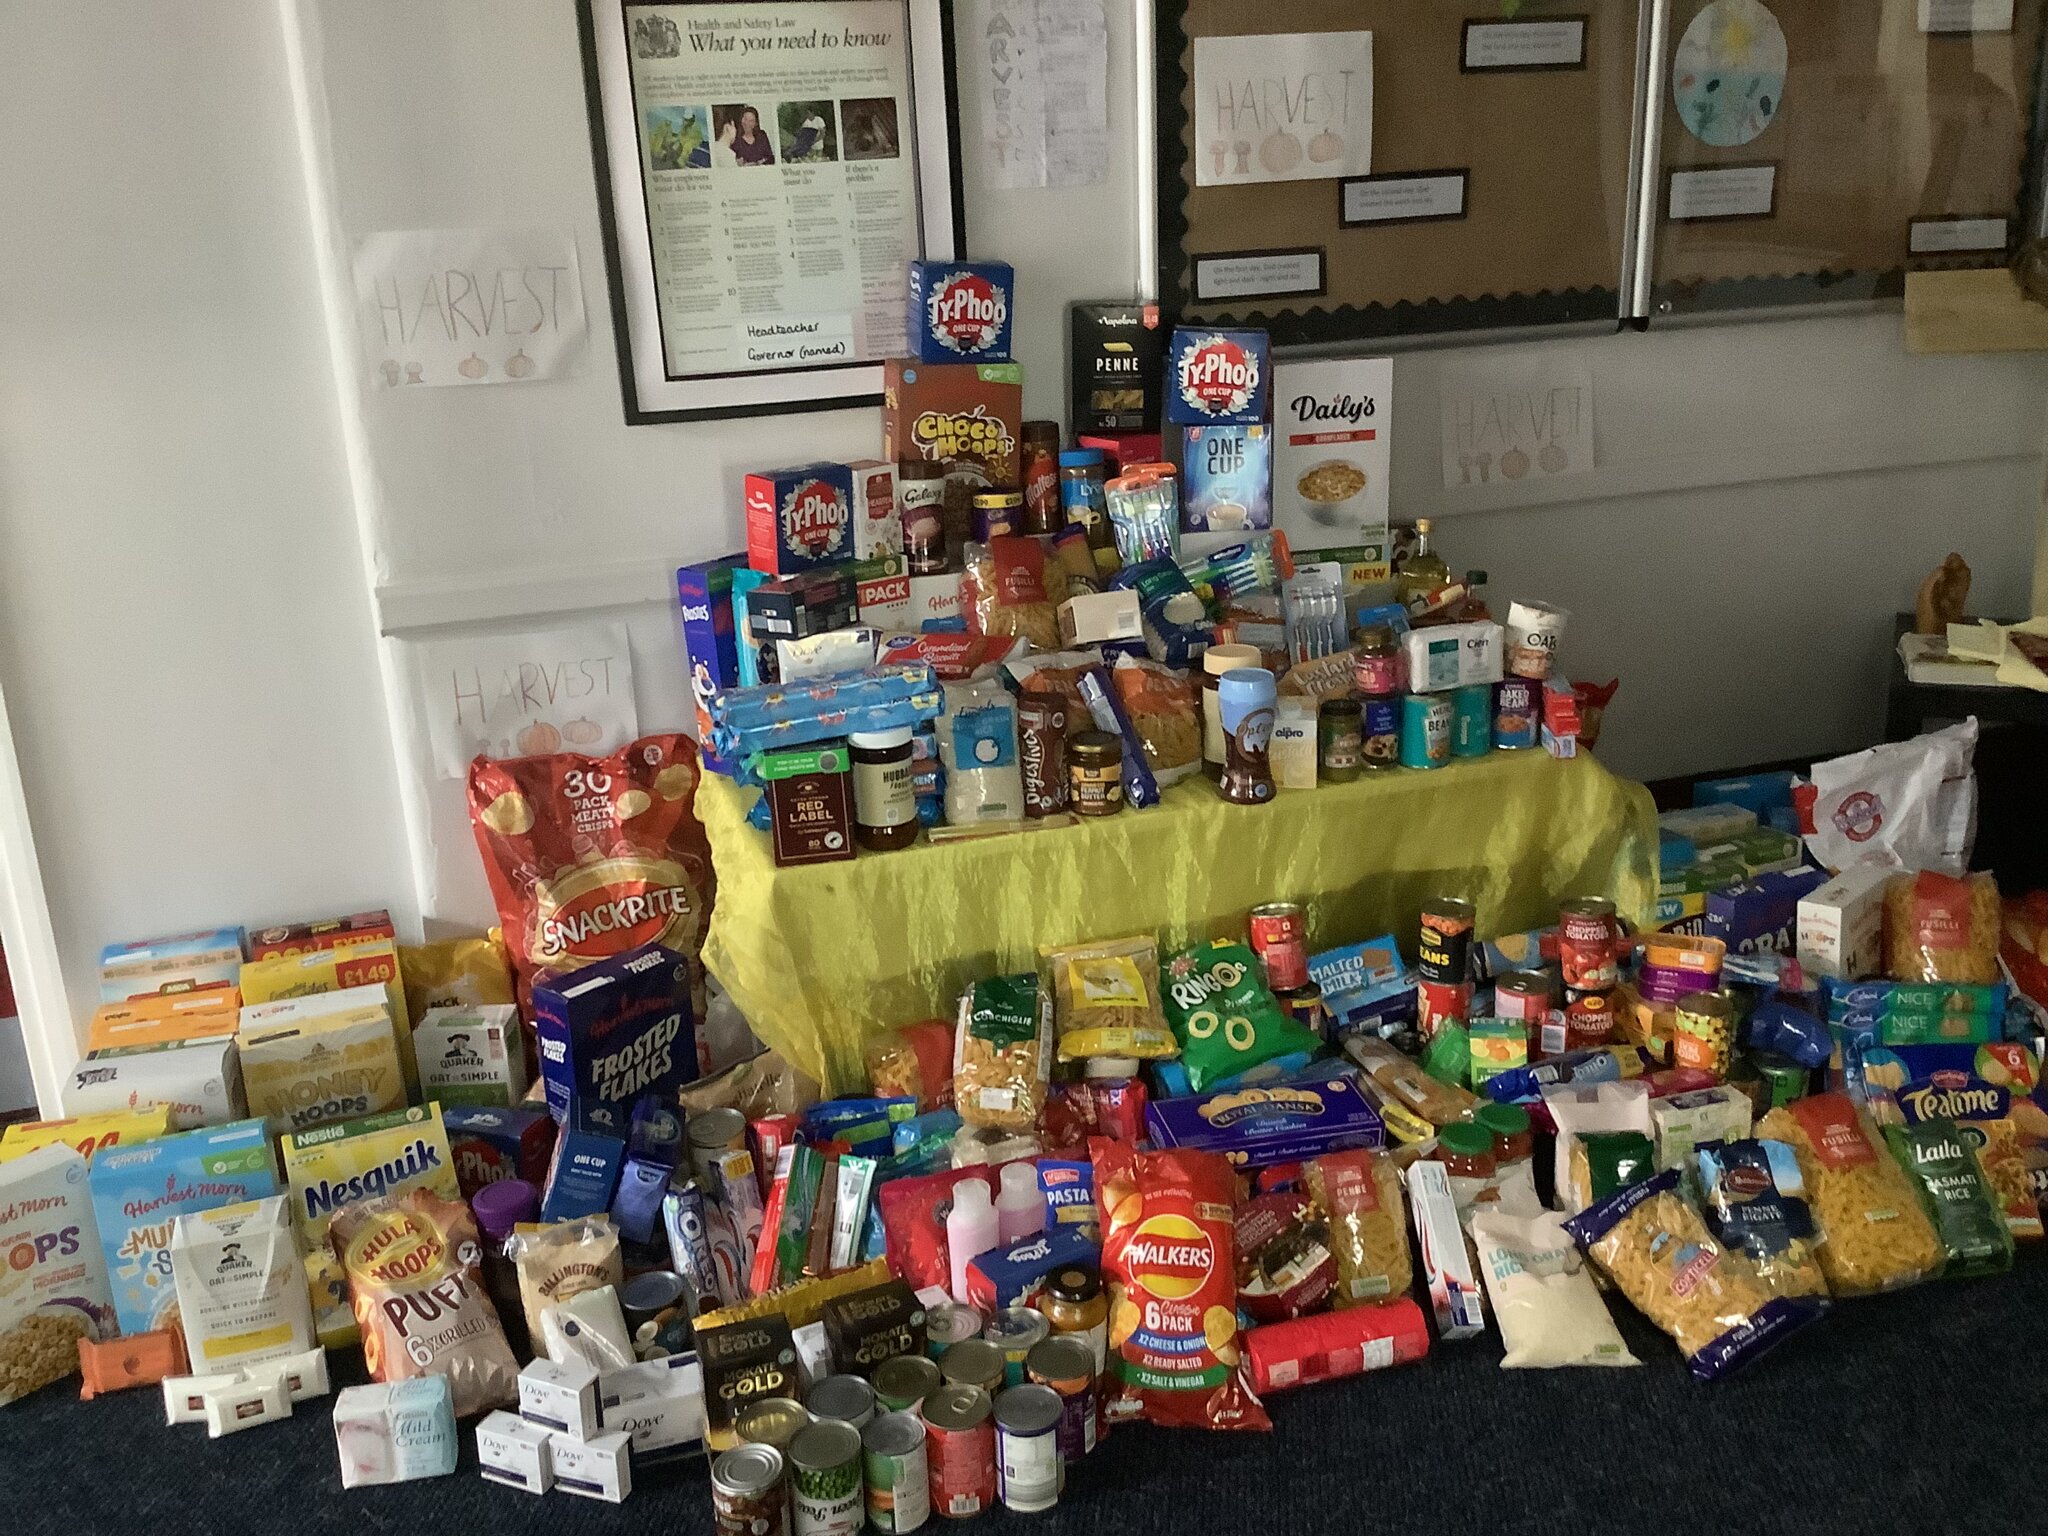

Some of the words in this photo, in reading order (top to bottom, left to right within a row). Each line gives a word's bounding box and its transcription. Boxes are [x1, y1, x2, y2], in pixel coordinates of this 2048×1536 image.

[687, 19, 722, 31] Health
[723, 18, 742, 29] and
[743, 17, 773, 30] Safety
[775, 16, 796, 28] Law
[688, 32, 736, 53] What
[740, 35, 774, 56] you
[777, 29, 816, 50] need
[821, 32, 839, 48] to
[842, 27, 892, 48] know
[1214, 70, 1355, 132] HARVEST
[373, 265, 568, 348] HARVEST
[953, 324, 968, 334] ONE
[968, 324, 982, 334] CUP
[1098, 313, 1138, 328] Napolina
[747, 322, 820, 338] Headteacher
[747, 347, 796, 361] Governor
[799, 341, 847, 359] (named)
[1096, 357, 1139, 372] PENNE
[1203, 388, 1217, 397] ONE
[1217, 388, 1231, 397] CUP
[1290, 394, 1376, 424] Daily's
[917, 414, 999, 439] Choco
[937, 433, 1008, 457] Hoops
[1207, 437, 1244, 456] ONE
[1207, 455, 1245, 475] CUP
[904, 487, 943, 505] Galaxy
[803, 530, 818, 541] ONE
[818, 528, 829, 540] CUP
[1353, 567, 1386, 581] NEW
[865, 582, 906, 602] PACK
[682, 604, 709, 622] FROSTIES
[452, 656, 614, 726] HARVEST
[1500, 689, 1530, 700] BAKED
[1500, 698, 1530, 709] BEANS
[1275, 727, 1304, 740] alpro
[563, 769, 613, 798] 30
[573, 795, 612, 811] PACK
[797, 800, 825, 812] RED
[571, 804, 617, 823] MEATY
[789, 810, 834, 823] LABEL
[577, 819, 614, 834] CRISPS
[808, 838, 821, 848] 80
[541, 887, 692, 956] SNACKRITE
[1566, 924, 1607, 935] CHOPPED
[1920, 919, 1960, 930] FUSILLI
[1565, 930, 1609, 941] TOMATOES
[344, 964, 391, 986] £1.49
[1308, 956, 1364, 982] MALTED
[1321, 971, 1363, 997] MILK
[1897, 992, 1932, 1006] NICE
[1569, 1018, 1615, 1031] TOMATOES
[1572, 1011, 1614, 1023] CHOPPED
[1891, 1015, 1928, 1030] NICE
[541, 1036, 567, 1053] FROSTED
[592, 1013, 682, 1084] FROSTED
[440, 1057, 484, 1069] QUAKER
[543, 1046, 565, 1064] FLAKES
[2008, 1050, 2020, 1065] 6
[429, 1073, 450, 1083] OAT
[460, 1071, 500, 1083] SIMPLE
[599, 1044, 673, 1102] FLAKES
[263, 1067, 388, 1118] HONEY
[290, 1096, 369, 1125] HOOPS
[1902, 1085, 2000, 1121] Teatime
[1821, 1132, 1862, 1147] FUSILLI
[1915, 1139, 1964, 1164] Laila
[573, 1153, 590, 1165] ONE
[590, 1156, 607, 1168] CUP
[304, 1139, 442, 1220] Nesquik
[1046, 1188, 1090, 1206] PASTA
[1336, 1183, 1367, 1198] PENNE
[1943, 1186, 1970, 1201] RICE
[20, 1194, 68, 1216] Morn
[123, 1184, 196, 1218] Harvest
[200, 1181, 248, 1197] Morn
[1741, 1203, 1778, 1213] PENNE
[1742, 1210, 1783, 1222] RIGATE
[362, 1219, 422, 1264] HULA
[370, 1237, 444, 1281] HOOPS
[1130, 1240, 1212, 1269] WALKERS
[216, 1260, 253, 1274] QUAKER
[209, 1276, 226, 1287] OAT
[233, 1269, 264, 1282] SIMPLE
[537, 1262, 611, 1298] BILLINGTON'S
[382, 1272, 470, 1338] PUFT
[210, 1319, 233, 1330] QUICK
[234, 1318, 244, 1326] TO
[1145, 1300, 1160, 1331] 6
[1162, 1315, 1193, 1332] PACK
[855, 1333, 914, 1364] GOLD
[1138, 1332, 1149, 1343] X2
[1148, 1335, 1176, 1350] CHEESE
[1183, 1336, 1206, 1351] ONION
[1142, 1355, 1153, 1366] X2
[1153, 1356, 1176, 1369] READY
[1176, 1355, 1202, 1369] SALTED
[723, 1361, 778, 1383] MOKATE
[1140, 1373, 1152, 1385] X2
[1151, 1374, 1169, 1387] SALT
[1174, 1374, 1205, 1388] VINEGAR
[524, 1382, 551, 1399] Dove
[718, 1371, 784, 1400] GOLD
[398, 1419, 432, 1436] Mild
[621, 1412, 665, 1432] Dove
[395, 1432, 447, 1448] Cream
[482, 1435, 509, 1452] Dove
[556, 1446, 584, 1462] Dove
